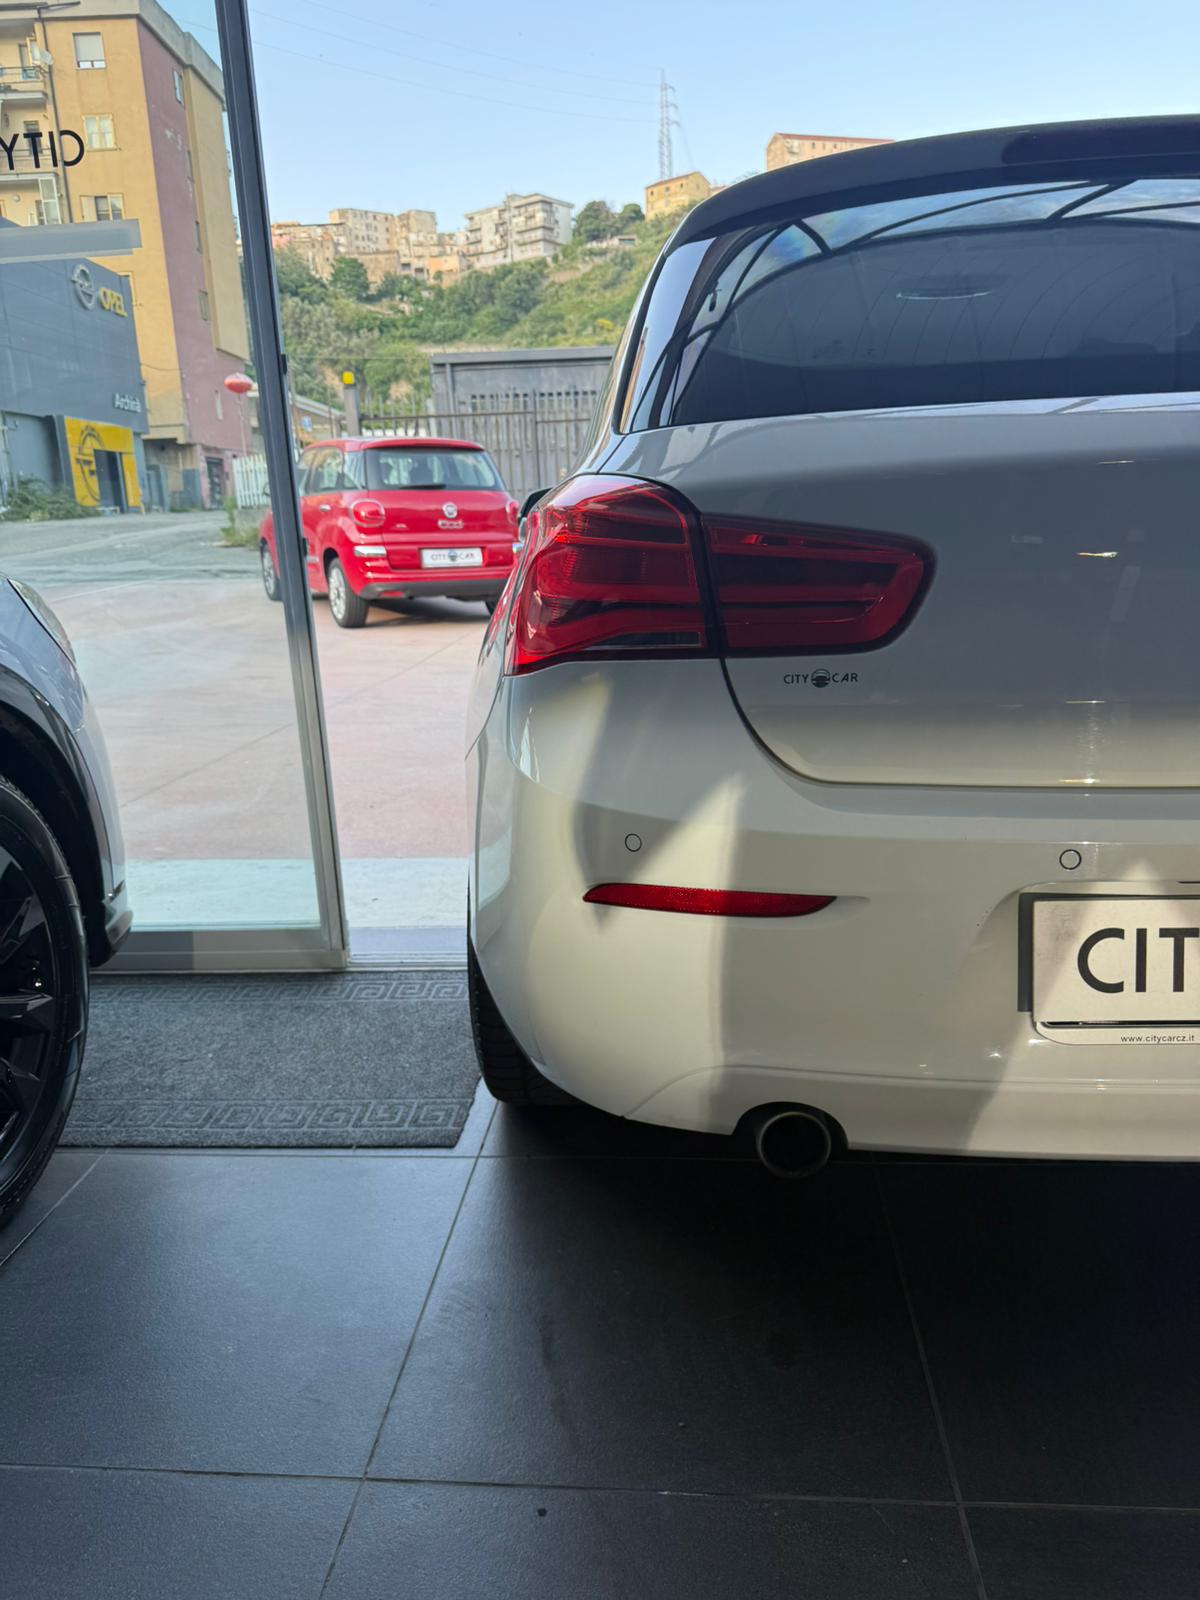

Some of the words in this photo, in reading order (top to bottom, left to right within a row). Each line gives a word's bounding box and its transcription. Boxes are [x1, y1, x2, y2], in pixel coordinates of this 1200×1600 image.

[99, 287, 128, 317] OPEL
[783, 673, 809, 684] CITY
[831, 672, 859, 683] CAR
[1077, 927, 1200, 994] CIT
[1120, 1034, 1195, 1044] www.citycarcz.it
